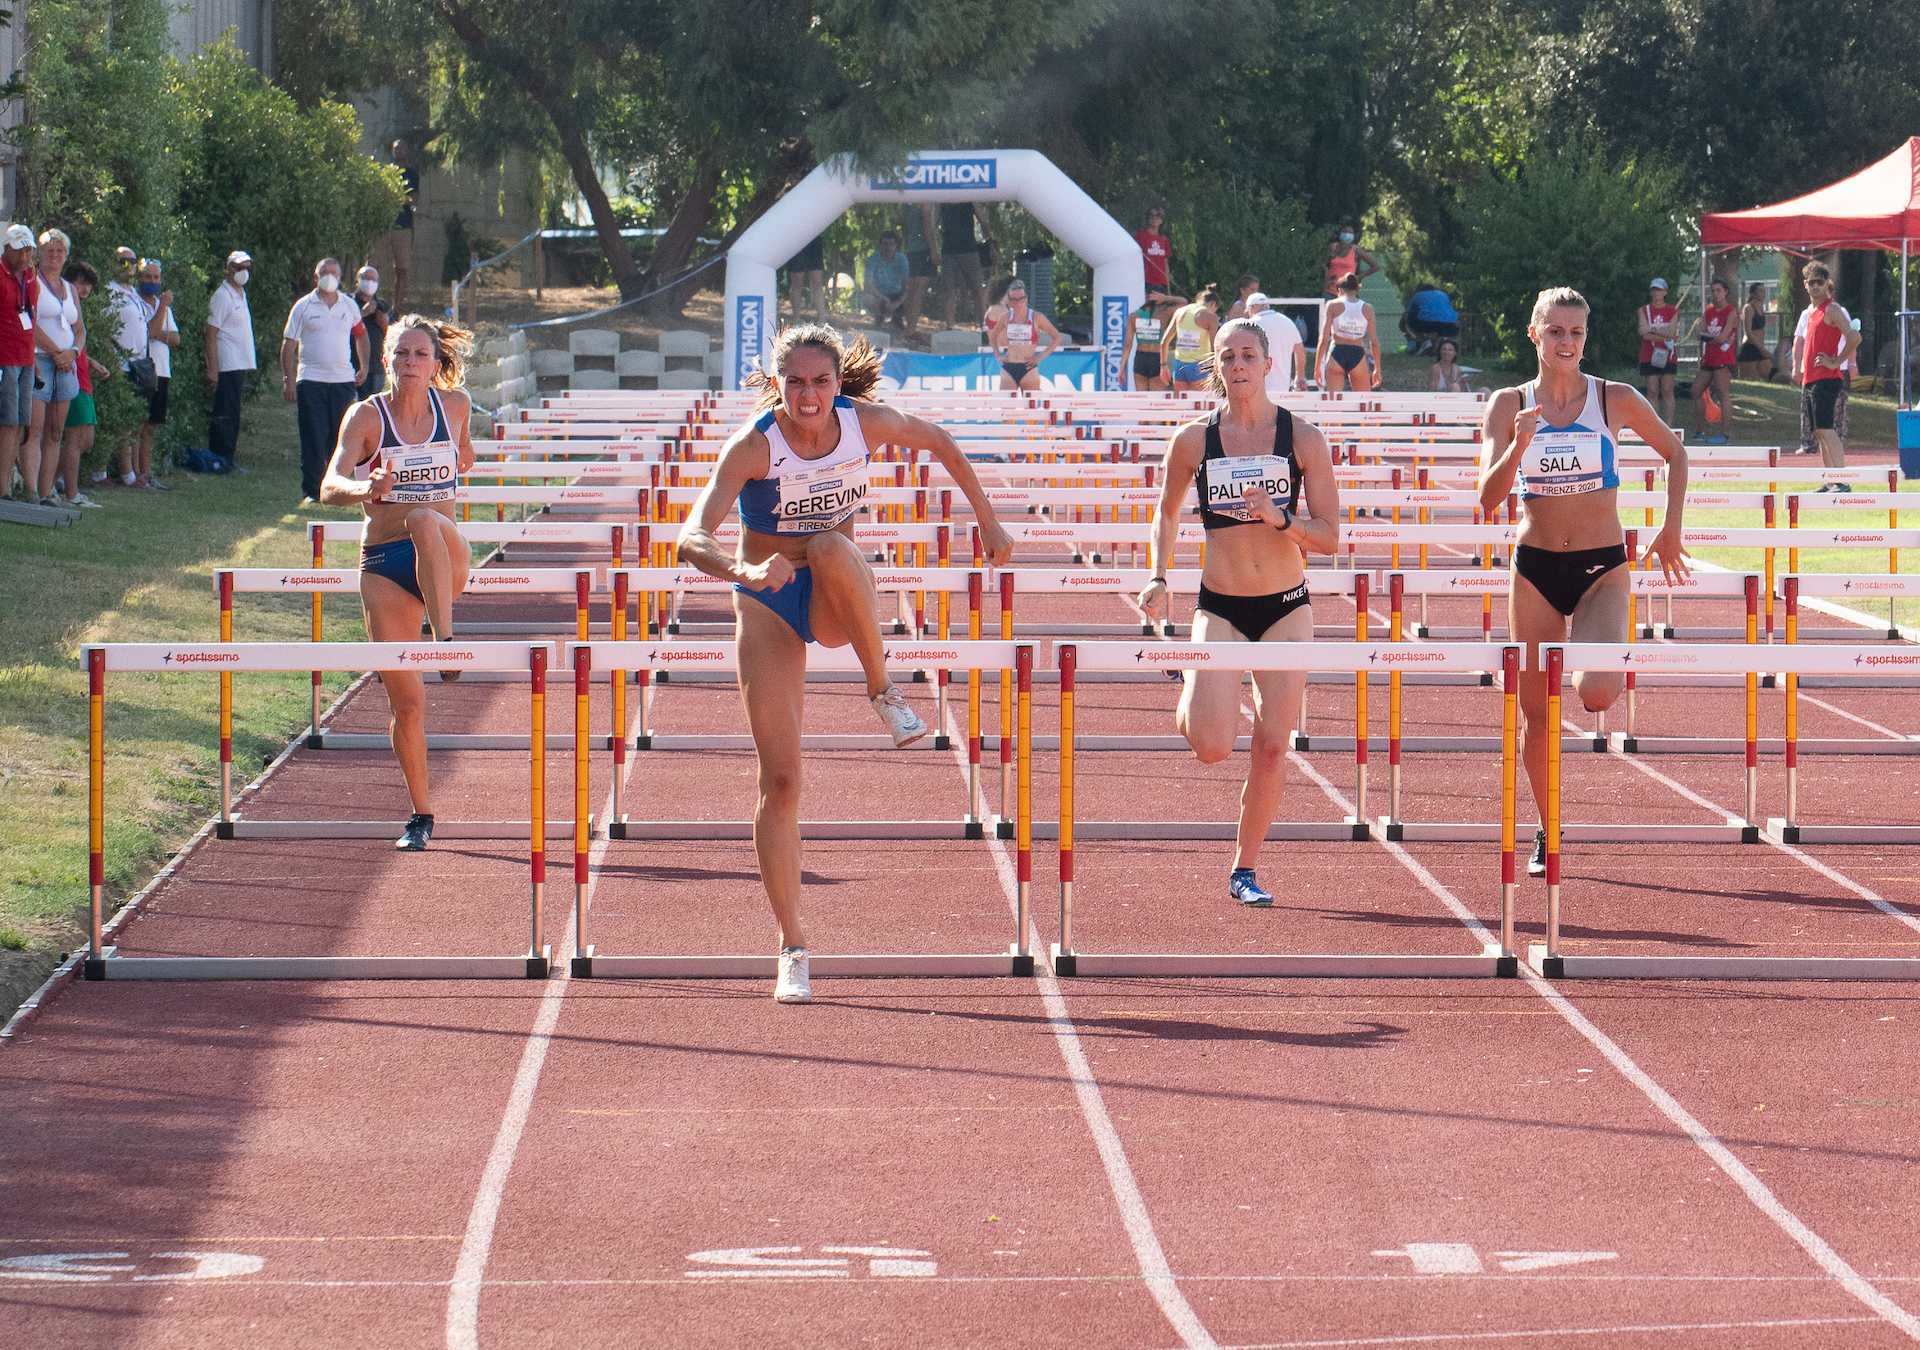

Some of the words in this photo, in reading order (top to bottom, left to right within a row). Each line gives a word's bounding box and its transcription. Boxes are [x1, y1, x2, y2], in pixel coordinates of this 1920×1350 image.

[876, 164, 990, 185] CATHLON
[741, 301, 758, 387] CATHLON
[1540, 456, 1582, 473] SALA
[1542, 485, 1576, 495] FIRENZE
[1578, 481, 1596, 493] 2020
[397, 493, 431, 502] FIRENZE
[433, 491, 449, 500] 2020
[785, 484, 867, 516] GEREVINI
[289, 575, 342, 585] sportissimo
[478, 575, 531, 585] sportissimo
[876, 575, 924, 585] portissimo
[1069, 576, 1122, 586] sportissimo
[1854, 580, 1906, 590] sportissimo
[1282, 587, 1304, 603] NIKE
[176, 652, 240, 664] sportissimo
[410, 651, 475, 663] sportissimo
[661, 651, 725, 663] sportissimo
[894, 650, 959, 662] sportissimo
[1147, 651, 1212, 663] sportissimo
[1381, 652, 1446, 664] sportissimo
[1634, 654, 1699, 665] sportissimo
[1866, 655, 1920, 667] sportissim
